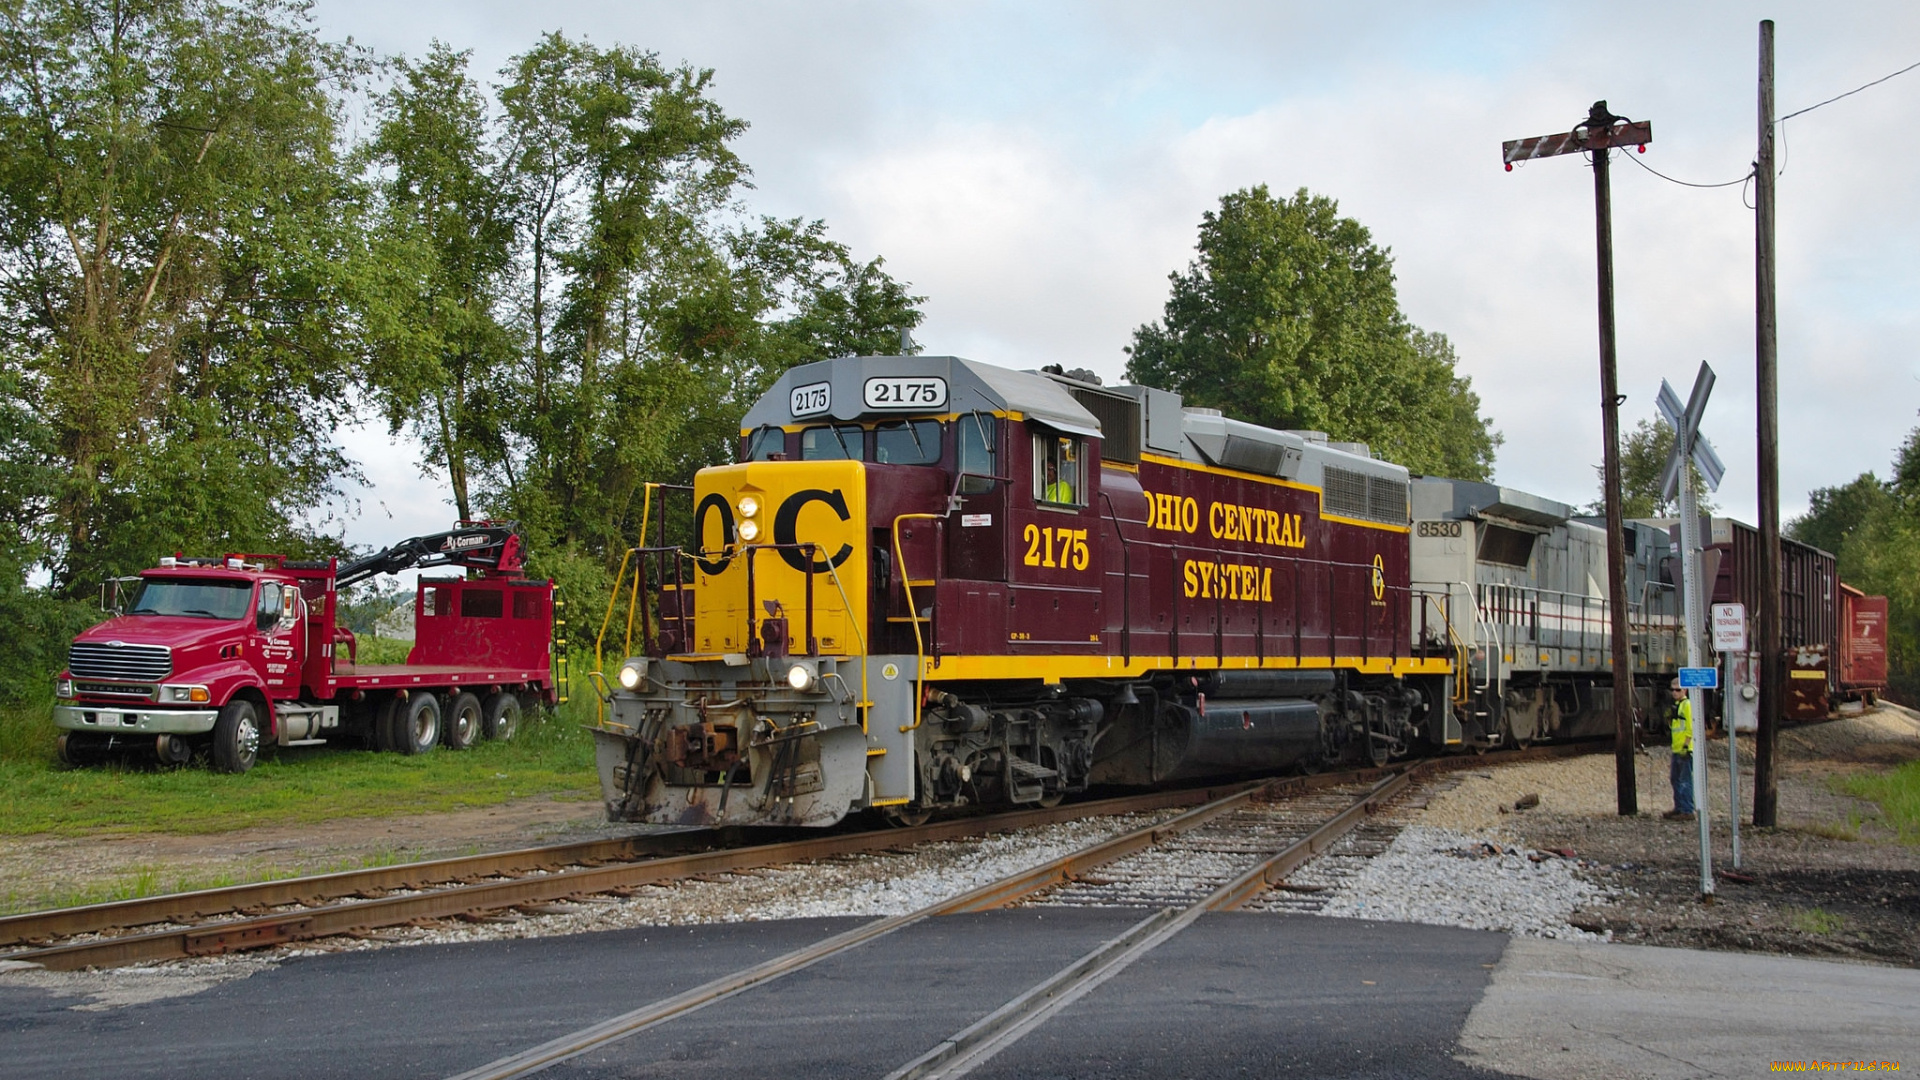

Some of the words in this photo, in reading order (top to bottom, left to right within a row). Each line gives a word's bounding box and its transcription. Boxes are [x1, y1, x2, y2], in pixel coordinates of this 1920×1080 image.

[796, 388, 826, 411] 2175
[874, 383, 937, 403] 2175
[1144, 490, 1199, 534] OHIO
[1209, 501, 1306, 548] CENTRAL
[1420, 522, 1459, 537] 8530
[457, 536, 484, 547] Corman
[1024, 523, 1089, 571] 2175
[1184, 559, 1272, 602] SYSTEM
[1723, 607, 1733, 617] NO
[1716, 618, 1741, 626] TRESPASSING
[926, 661, 933, 675] F
[85, 685, 144, 693] STERLING
